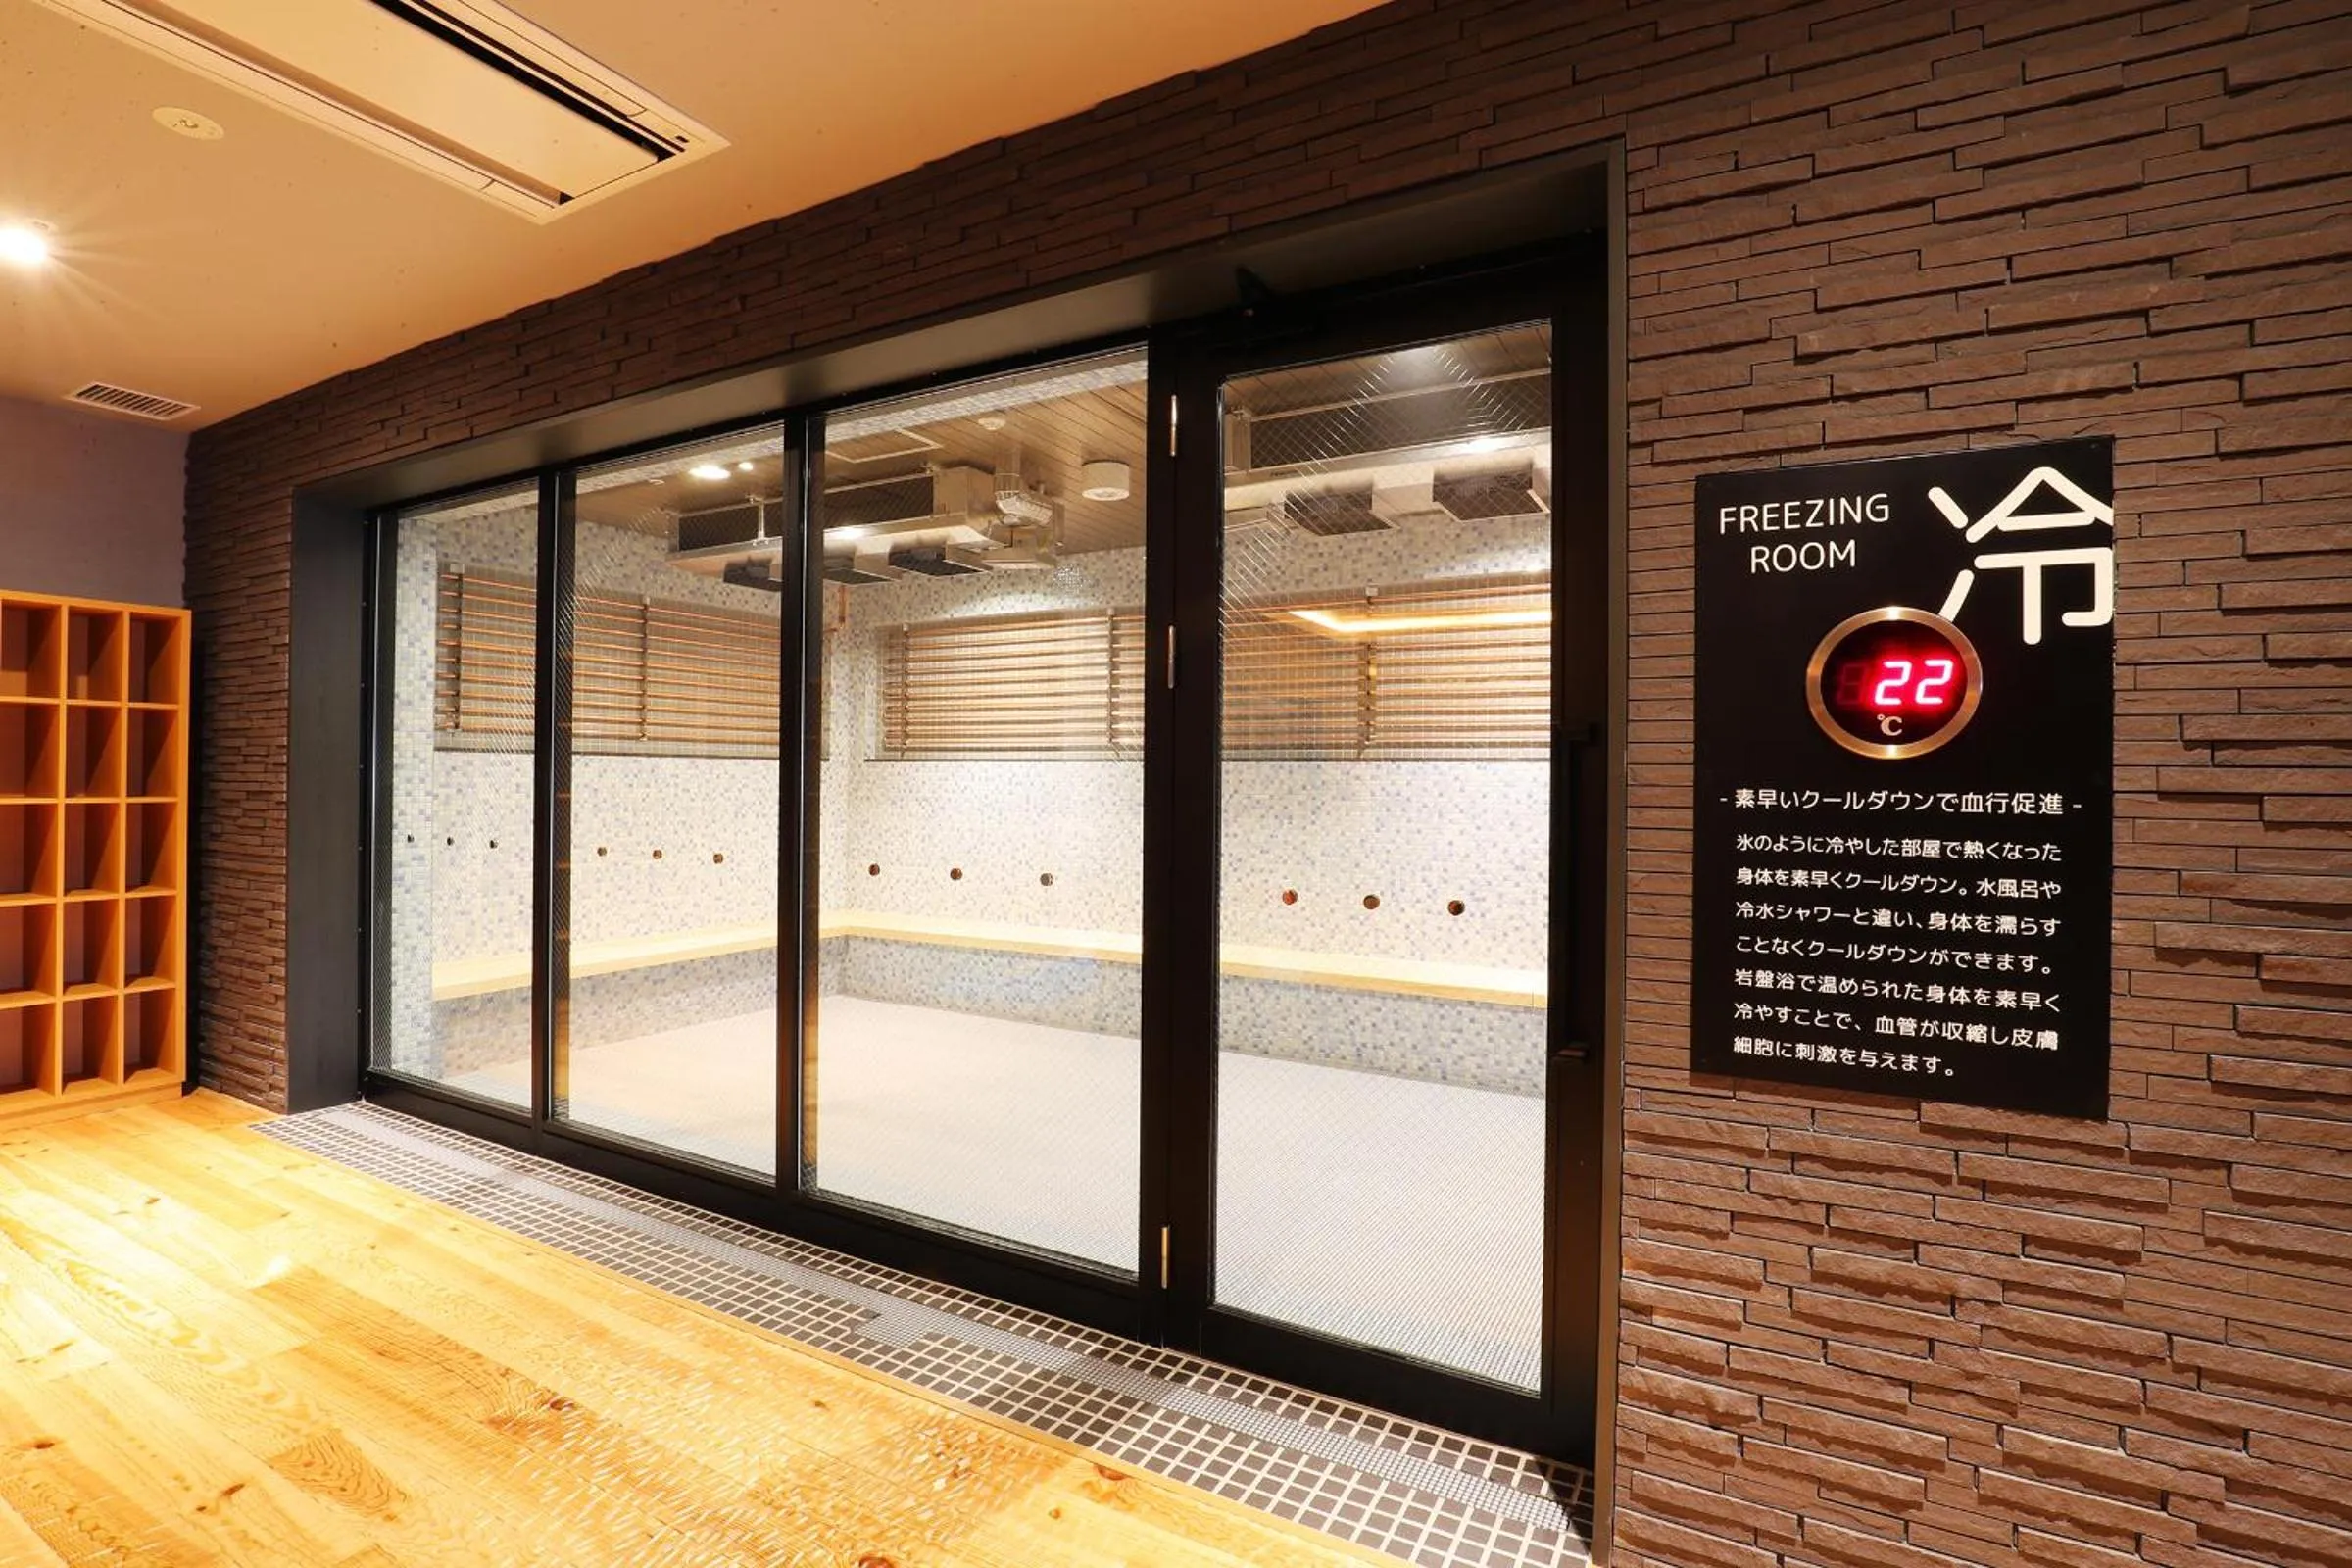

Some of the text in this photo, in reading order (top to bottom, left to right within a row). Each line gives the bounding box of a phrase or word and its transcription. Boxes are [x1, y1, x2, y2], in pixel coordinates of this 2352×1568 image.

[1720, 493, 1889, 534] FREEZING
[1751, 539, 1855, 573] ROOM
[1928, 466, 2114, 645] 冷
[1875, 660, 1953, 705] 22
[1736, 834, 2062, 861] 氷のように冷やした部屋で熱くなった
[1737, 936, 2051, 974] ことなくクールダウンができます。
[1735, 969, 2060, 1012] 岩盤浴で温められた身体を素早く
[1734, 1036, 1954, 1076] 細胞に刺激を与えます。
